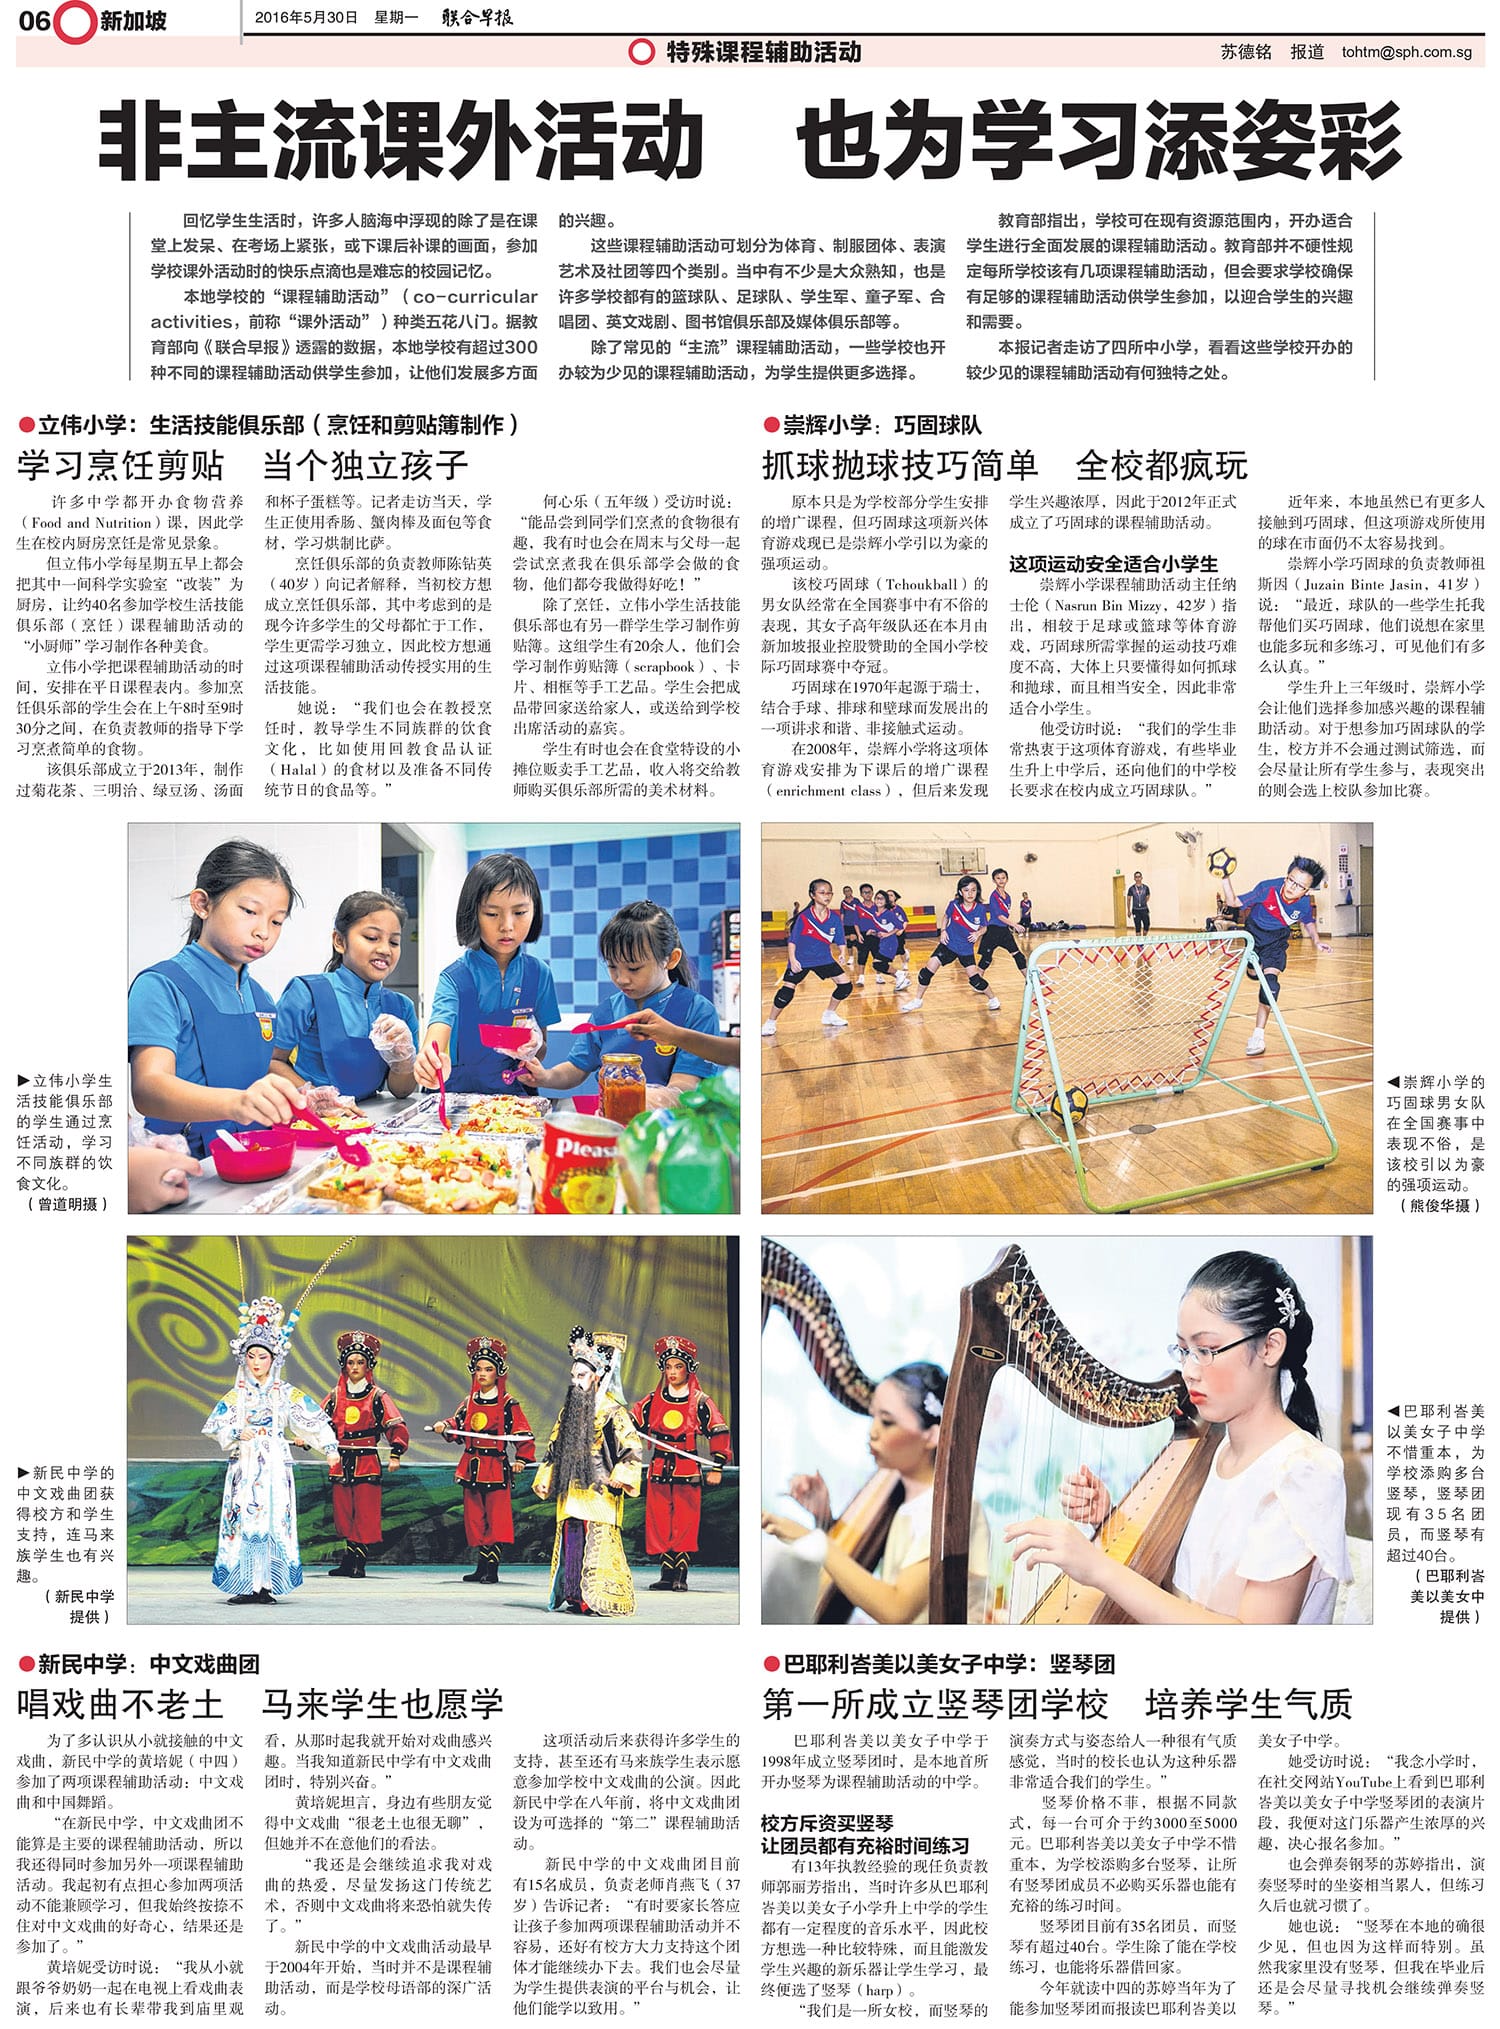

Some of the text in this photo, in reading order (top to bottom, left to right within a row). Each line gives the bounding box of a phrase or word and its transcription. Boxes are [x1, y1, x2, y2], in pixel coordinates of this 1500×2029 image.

[19, 11, 51, 31] 06
[101, 10, 167, 31] 新加坡
[256, 8, 513, 27] 2016年5月30日 星期一 联合早报
[667, 40, 861, 63] 特殊课程辅助活动
[1221, 43, 1472, 61] 苏德铭 报道 tohtm@sph.com.sg
[99, 98, 1402, 181] 非主流课外活动 也为学习添姿彩
[559, 212, 614, 229] 的兴趣。
[967, 314, 1022, 330] 和需要。
[38, 413, 517, 436] 立伟小学：生活技能俱乐部（烹饪和剪贴簿制作）
[784, 414, 982, 435] 崇辉小学：巧固球队
[18, 449, 468, 481] 学习烹饪剪贴 当个独立孩子
[762, 449, 1248, 481] 抓球抛球技巧简单 全校都疯玩
[53, 494, 243, 510] 许多中学都开办食物营养
[792, 494, 988, 510] 原本只是为学校部分学生安排
[265, 535, 391, 551] 材，学习烘制比萨。
[762, 535, 987, 551] 育游戏现已是崇辉小学引以为豪的
[48, 555, 243, 572] 但立伟小学每星期五早上都会
[296, 555, 491, 571] 烹饪俱乐部的负责教师陈钻英
[513, 555, 739, 572] 尝试烹煮我在俱乐部学会做的食
[761, 556, 826, 571] 强项运动。
[1009, 554, 1218, 574] 这项运动安全适合小学生
[1288, 555, 1485, 571] 崇辉小学巧固球的负责教师祖
[1040, 576, 1236, 592] 崇辉小学课程辅助活动主任纳
[762, 597, 987, 613] 男女队经常在全国赛事中有不俗的
[513, 617, 740, 633] 俱乐部也有另一群学生学习制作剪
[762, 638, 987, 654] 新加坡报业控股赞助的全国小学校
[47, 659, 243, 675] 立伟小学把课程辅助活动的时
[265, 658, 491, 674] 过这项课程辅助活动传授实用的生
[762, 658, 887, 675] 际巧固球赛中夺冠。
[265, 679, 316, 695] 活技能。
[1009, 700, 1090, 716] 适合小学生。
[1258, 699, 1485, 716] 会让他们选择参加感兴趣的课程辅
[514, 720, 624, 736] 出席活动的嘉宾。
[17, 741, 143, 757] 习烹煮简单的食物。
[543, 741, 740, 757] 学生有时也会在食堂特设的小
[762, 762, 988, 778] 育游戏安排为下课后的增广课程
[33, 1073, 112, 1089] 立伟小学生
[1404, 1074, 1484, 1090] 崇辉小学的
[17, 1093, 112, 1109] 活技能俱乐部
[1387, 1095, 1485, 1110] 巧固球男女队
[17, 1113, 112, 1130] 的学生通过烹
[1387, 1115, 1484, 1131] 在全国赛事中
[17, 1134, 111, 1150] 饪活动，学习
[1387, 1136, 1485, 1152] 表现不俗，是
[17, 1155, 112, 1171] 不同族群的饮
[1387, 1156, 1484, 1172] 该校引以为豪
[17, 1176, 68, 1191] 食文化。
[1388, 1177, 1468, 1193] 的强项运动。
[1405, 1403, 1484, 1419] 巴耶利峇美
[1388, 1424, 1484, 1440] 以美女子中学
[1387, 1444, 1484, 1460] 不惜重本，为
[34, 1465, 114, 1481] 新民中学的
[1387, 1465, 1484, 1481] 学校添购多台
[18, 1485, 114, 1501] 中文戏曲团获
[1387, 1486, 1484, 1501] 竖琴，竖琴团
[17, 1506, 114, 1522] 得校方和学生
[1387, 1506, 1484, 1522] 现有35名团
[17, 1526, 114, 1542] 支持，连马来
[1388, 1526, 1484, 1542] 员，而竖琴有
[16, 1547, 114, 1564] 族学生也有兴
[1387, 1547, 1455, 1563] 超过40台。
[17, 1568, 38, 1584] 趣。
[1411, 1589, 1484, 1604] 美以美女中
[39, 1653, 259, 1675] 新民中学：中文戏曲团
[785, 1653, 1115, 1675] 巴耶利峇美以美女子中学：竖琴团
[18, 1688, 503, 1720] 唱戏曲不老土 马来学生也愿学
[763, 1688, 1352, 1720] 第一所成立竖琴团学校 培养学生气质
[48, 1733, 243, 1748] 为了多认识从小就接触的中文
[543, 1732, 739, 1748] 这项活动后来获得许多学生的
[795, 1733, 988, 1749] 巴耶利峇美以美女子中学于
[1010, 1733, 1236, 1749] 演奏方式与姿态给人一种很有气质
[1259, 1733, 1339, 1749] 美女子中学。
[1259, 1774, 1484, 1789] 在社交网站YouTube上看到巴耶利
[17, 1794, 112, 1810] 曲和中国舞蹈。
[1259, 1794, 1484, 1810] 峇美以美女子中学竖琴团的表演片
[761, 1813, 894, 1833] 校方斥资买竖琴
[761, 1836, 969, 1856] 让团员都有充裕时间练习
[16, 1856, 243, 1872] 我还得同时参加另外一项课程辅助
[546, 1856, 740, 1872] 新民中学的中文戏曲团目前
[792, 1858, 988, 1874] 有13年执教经验的现任负责教
[1010, 1877, 1236, 1893] 有竖琴团成员不必购买乐器也能有
[762, 1900, 988, 1916] 峇美以美女子小学升上中学的学生
[1010, 1898, 1121, 1913] 充裕的练习时间。
[1259, 1898, 1369, 1913] 久后也就习惯了。
[514, 1918, 740, 1934] 让孩子参加两项课程辅助活动并不
[295, 1939, 491, 1954] 新民中学的中文戏曲活动最早
[16, 1980, 243, 1996] 跟爷爷奶奶一起在电视上看戏曲表
[1040, 1980, 1235, 1996] 今年就读中四的苏婷当年为了
[1258, 1980, 1484, 1995] 还是会尽量寻找机会继续弹奏竖
[1010, 2000, 1236, 2016] 能参加竖琴团而报读巴耶利峇美以
